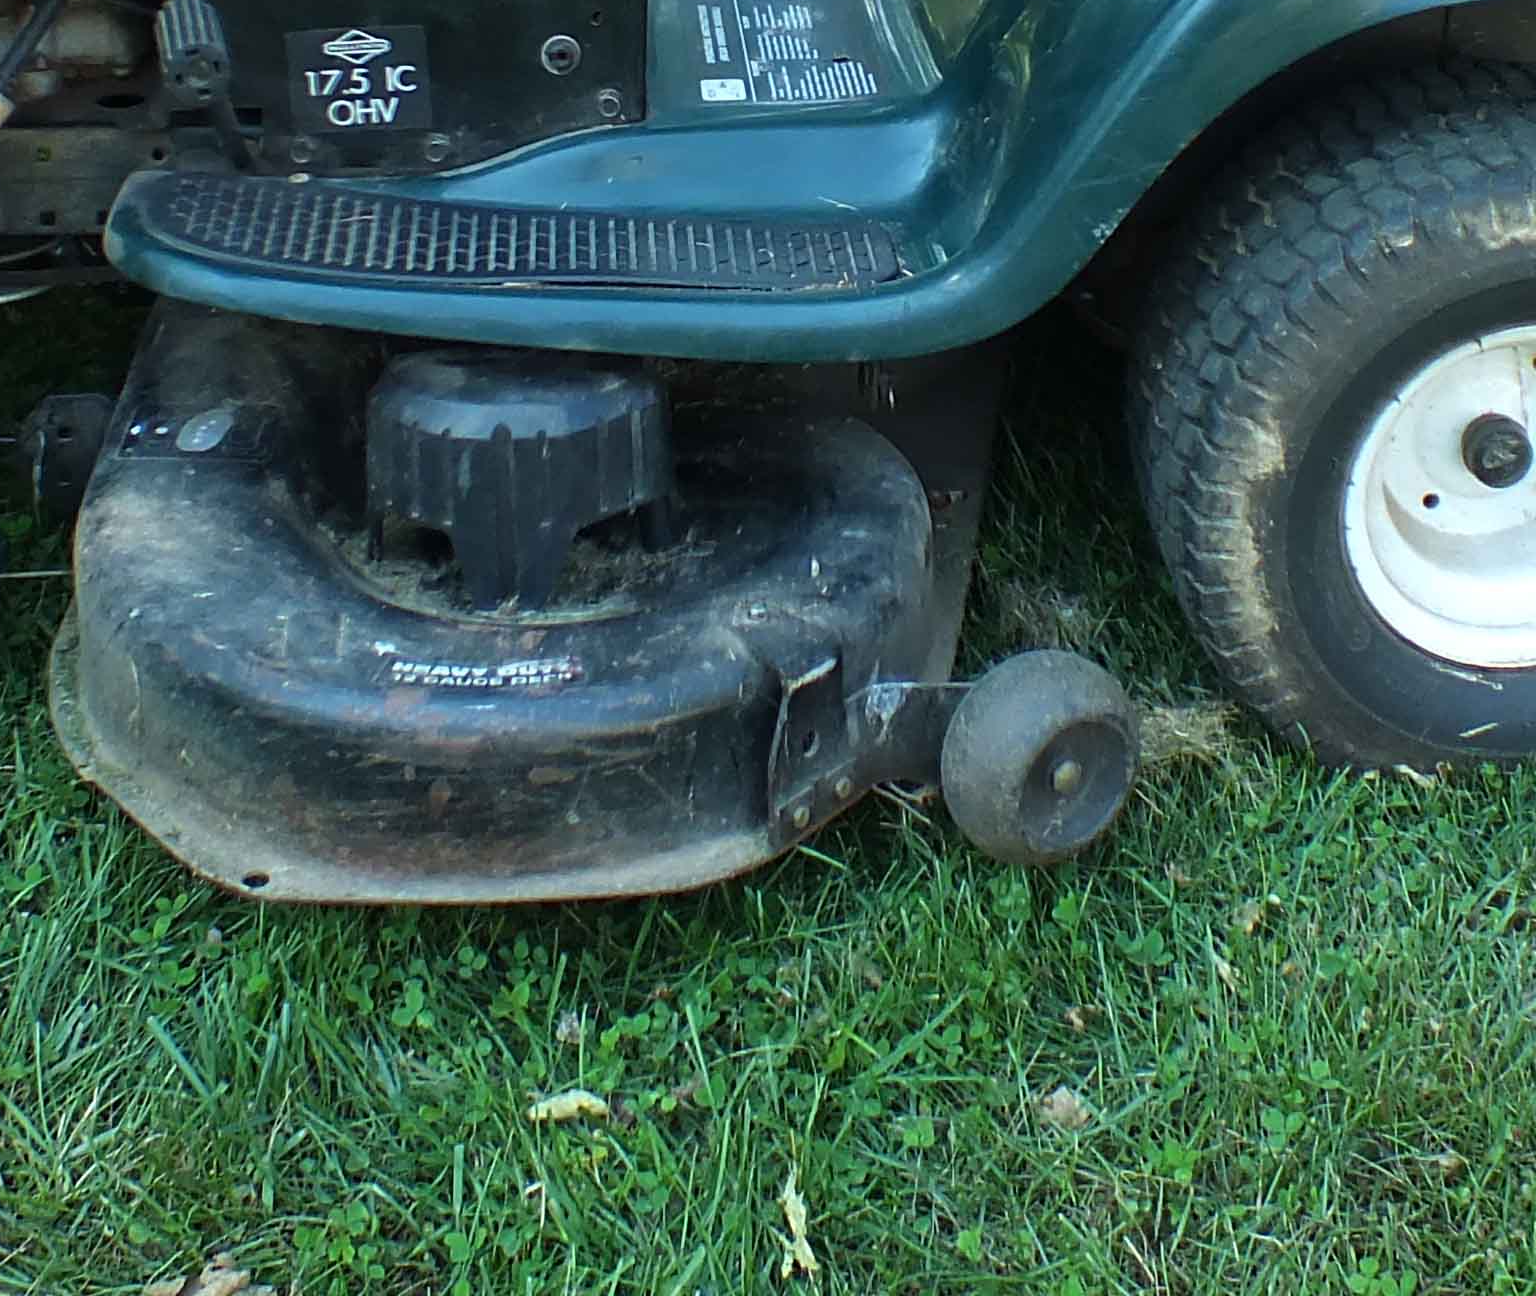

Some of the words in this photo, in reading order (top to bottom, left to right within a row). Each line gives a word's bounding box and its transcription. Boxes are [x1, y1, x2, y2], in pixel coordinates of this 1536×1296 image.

[304, 68, 371, 96] 17.5
[384, 65, 416, 92] IC
[327, 97, 399, 126] OHV
[391, 661, 488, 677] HEAVY
[497, 657, 571, 677] DUTY
